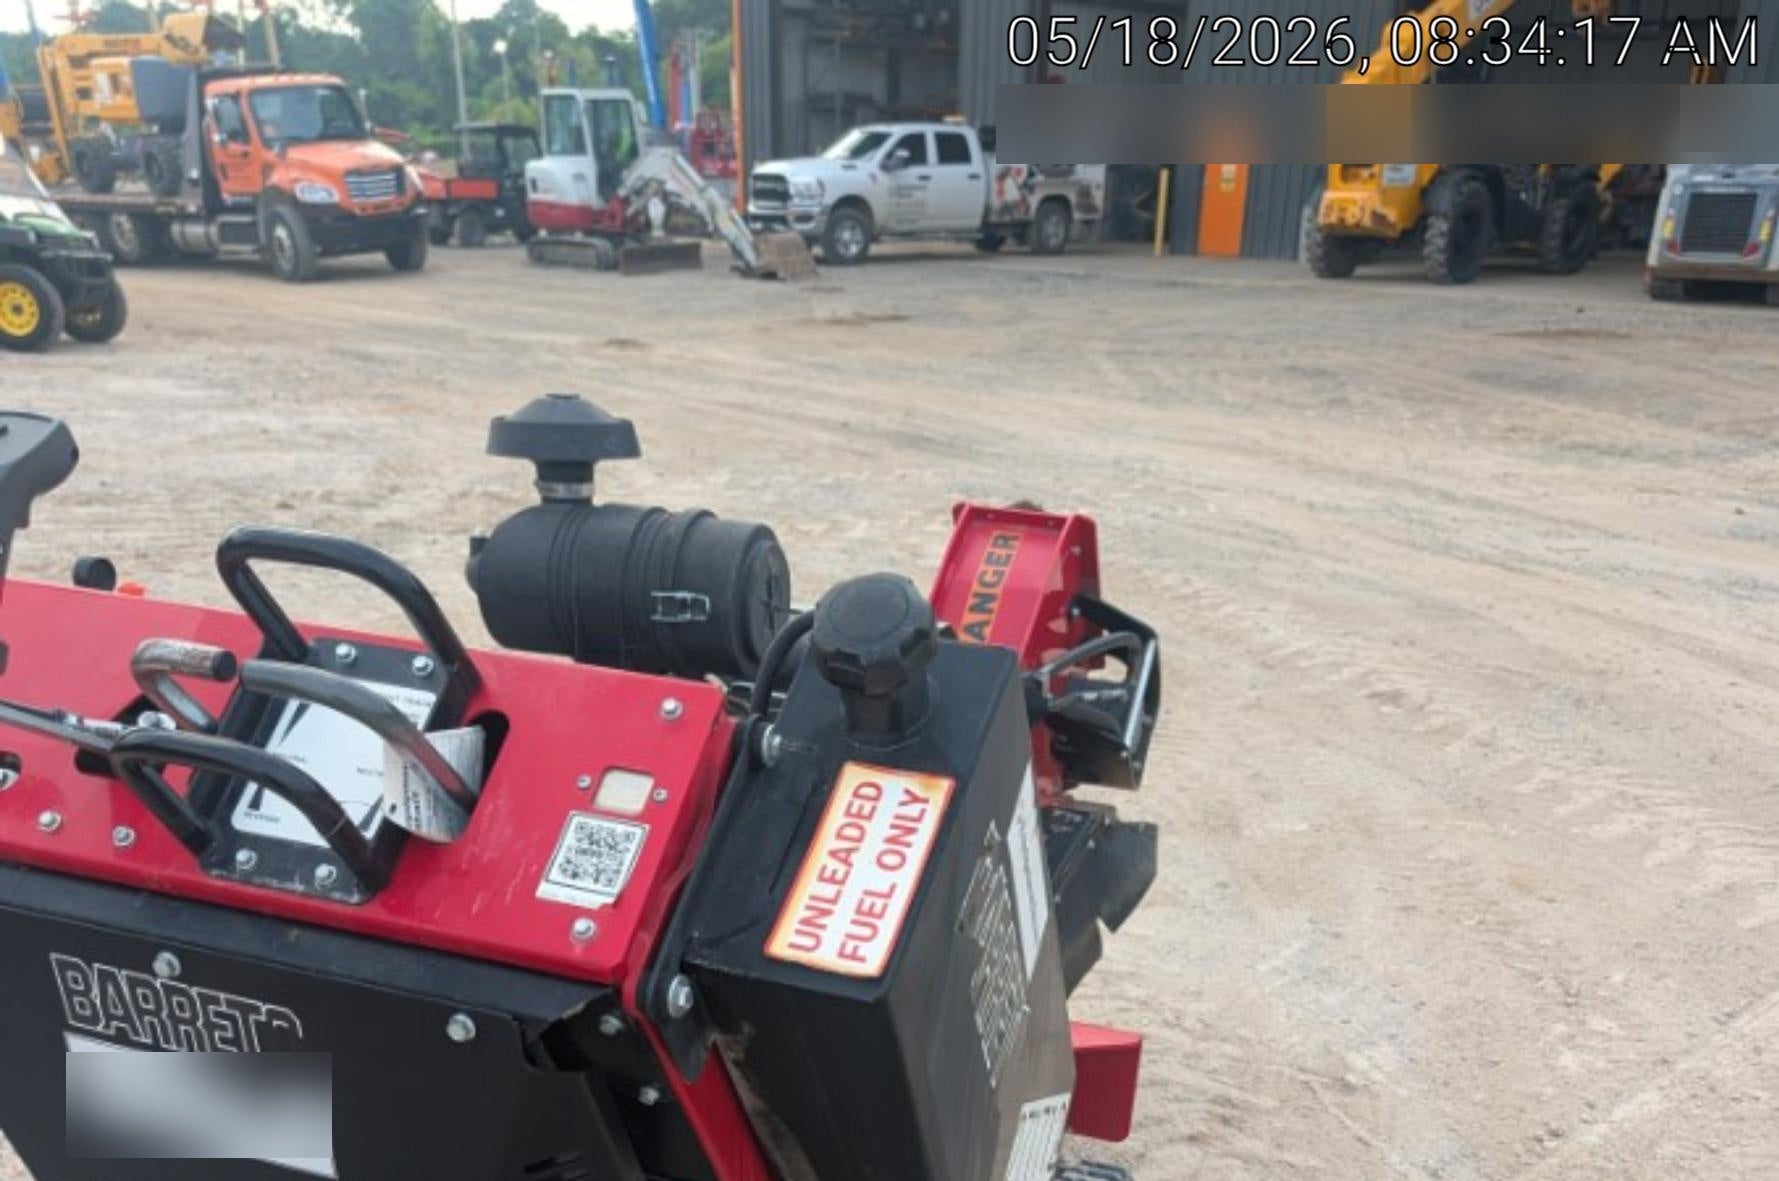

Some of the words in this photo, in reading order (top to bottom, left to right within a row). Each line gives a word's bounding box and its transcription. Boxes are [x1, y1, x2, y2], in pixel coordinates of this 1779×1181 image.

[961, 533, 1021, 645] ANGER
[787, 780, 884, 954] UNLEADED
[836, 881, 898, 964] FUEL
[874, 786, 931, 873] ONLY
